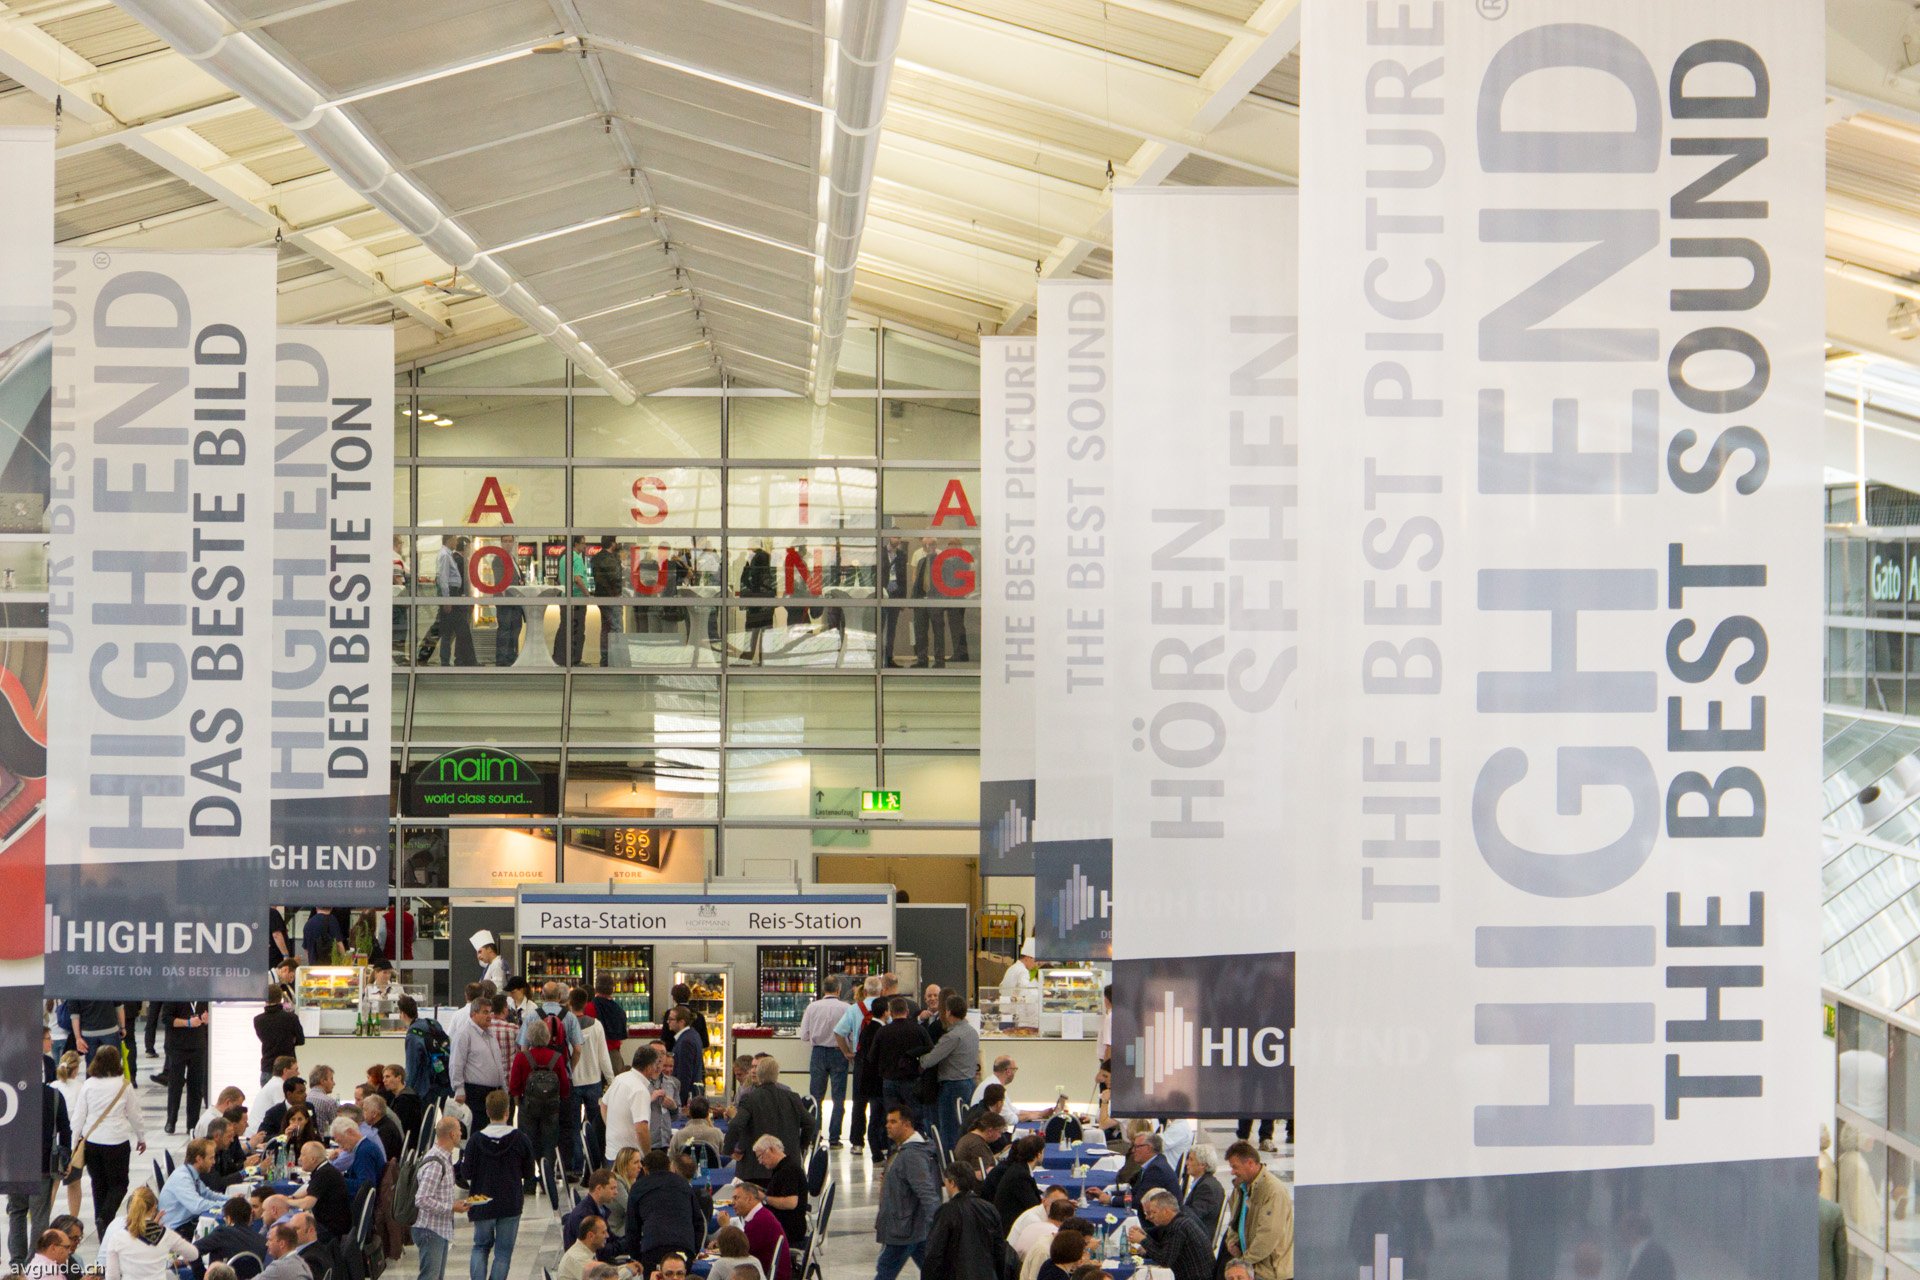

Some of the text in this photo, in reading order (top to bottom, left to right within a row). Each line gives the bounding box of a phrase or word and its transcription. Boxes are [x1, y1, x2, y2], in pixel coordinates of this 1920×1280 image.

[1362, 0, 1446, 921] THE BEST PICTURE
[1005, 344, 1036, 684] THE BEST PICTURE
[1066, 290, 1107, 694] THE BEST SOUND
[1227, 315, 1298, 714] SEHEN
[189, 323, 248, 838] DAS BESTE BILD
[271, 342, 330, 790] HIGH END
[328, 397, 373, 779] DER BESTE TON
[1665, 38, 1771, 1121] THE BEST SOUND
[1871, 554, 1901, 601] Gato
[1131, 508, 1227, 838] HÖREN
[89, 550, 189, 850] HIGH
[439, 752, 518, 782] naim
[424, 792, 533, 804] world class sound...
[815, 808, 854, 817] Lastenaufzug
[269, 844, 308, 870] GH
[491, 870, 544, 878] CATALOGUE
[1472, 568, 1662, 1147] HIGH
[281, 879, 299, 888] TON
[307, 879, 325, 888] DAS
[327, 879, 353, 889] BESTE
[355, 880, 376, 889] BILD
[67, 920, 164, 954] HIGH
[540, 911, 667, 930] Pasta-Station
[685, 919, 730, 927] HOFFMANN
[749, 911, 862, 930] Reis-Station
[66, 964, 250, 978] DER BESTE TON DAS BESTE BILD
